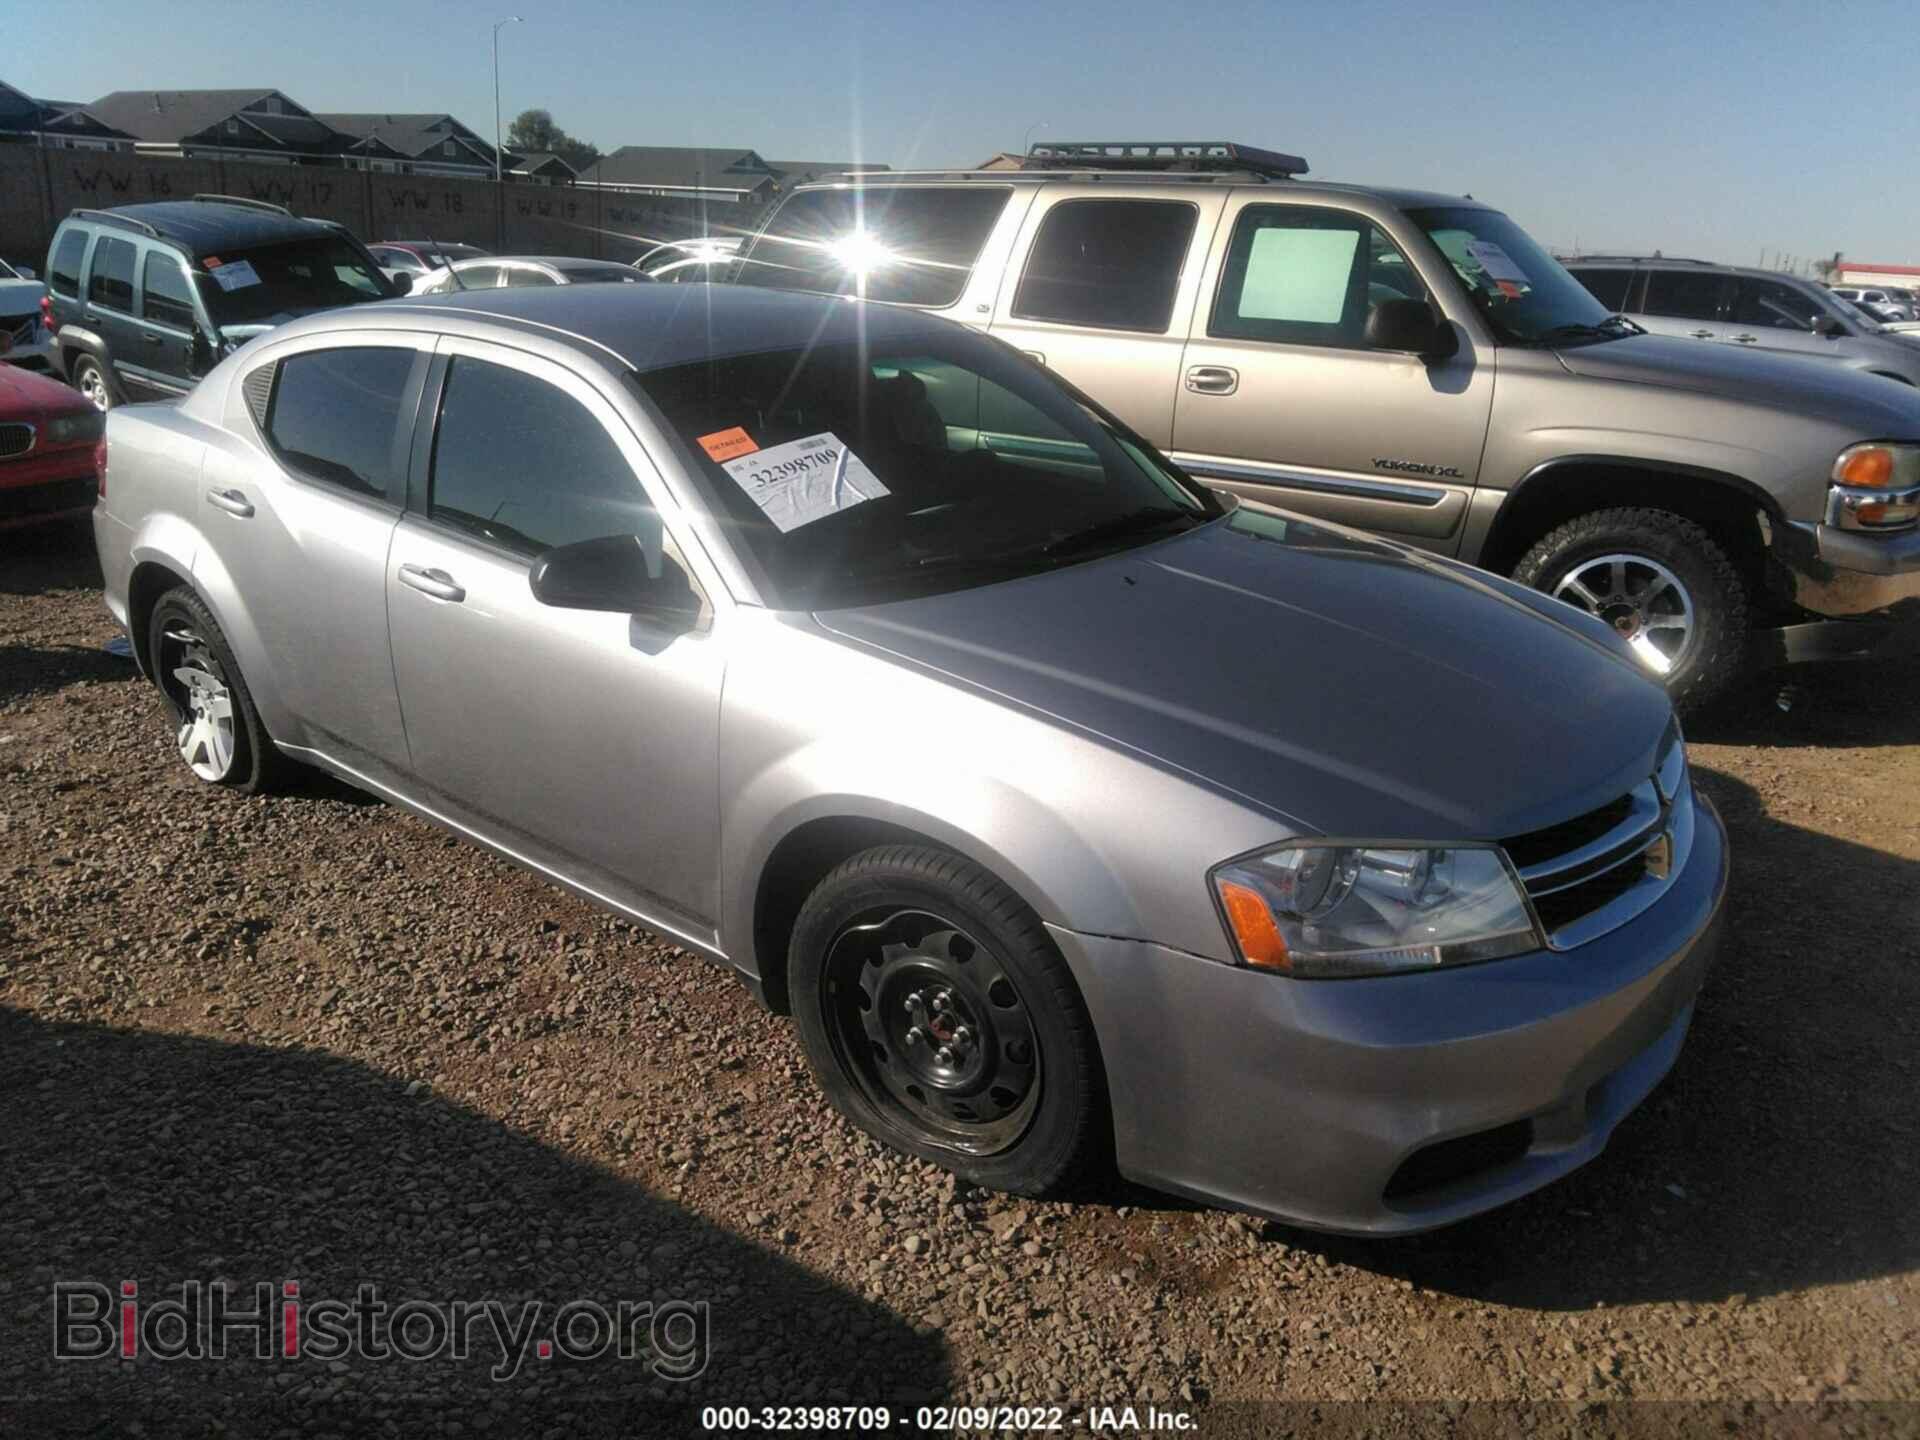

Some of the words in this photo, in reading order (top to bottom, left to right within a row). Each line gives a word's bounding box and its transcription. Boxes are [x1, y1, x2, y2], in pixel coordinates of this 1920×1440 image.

[73, 168, 133, 192] WW
[149, 172, 172, 194] 16
[311, 183, 333, 204] 17
[386, 188, 431, 209] WW
[444, 191, 465, 214] 18
[515, 199, 554, 216] WW
[750, 448, 840, 488] 32398709
[1371, 458, 1435, 474] YUKON
[1438, 466, 1465, 478] XL
